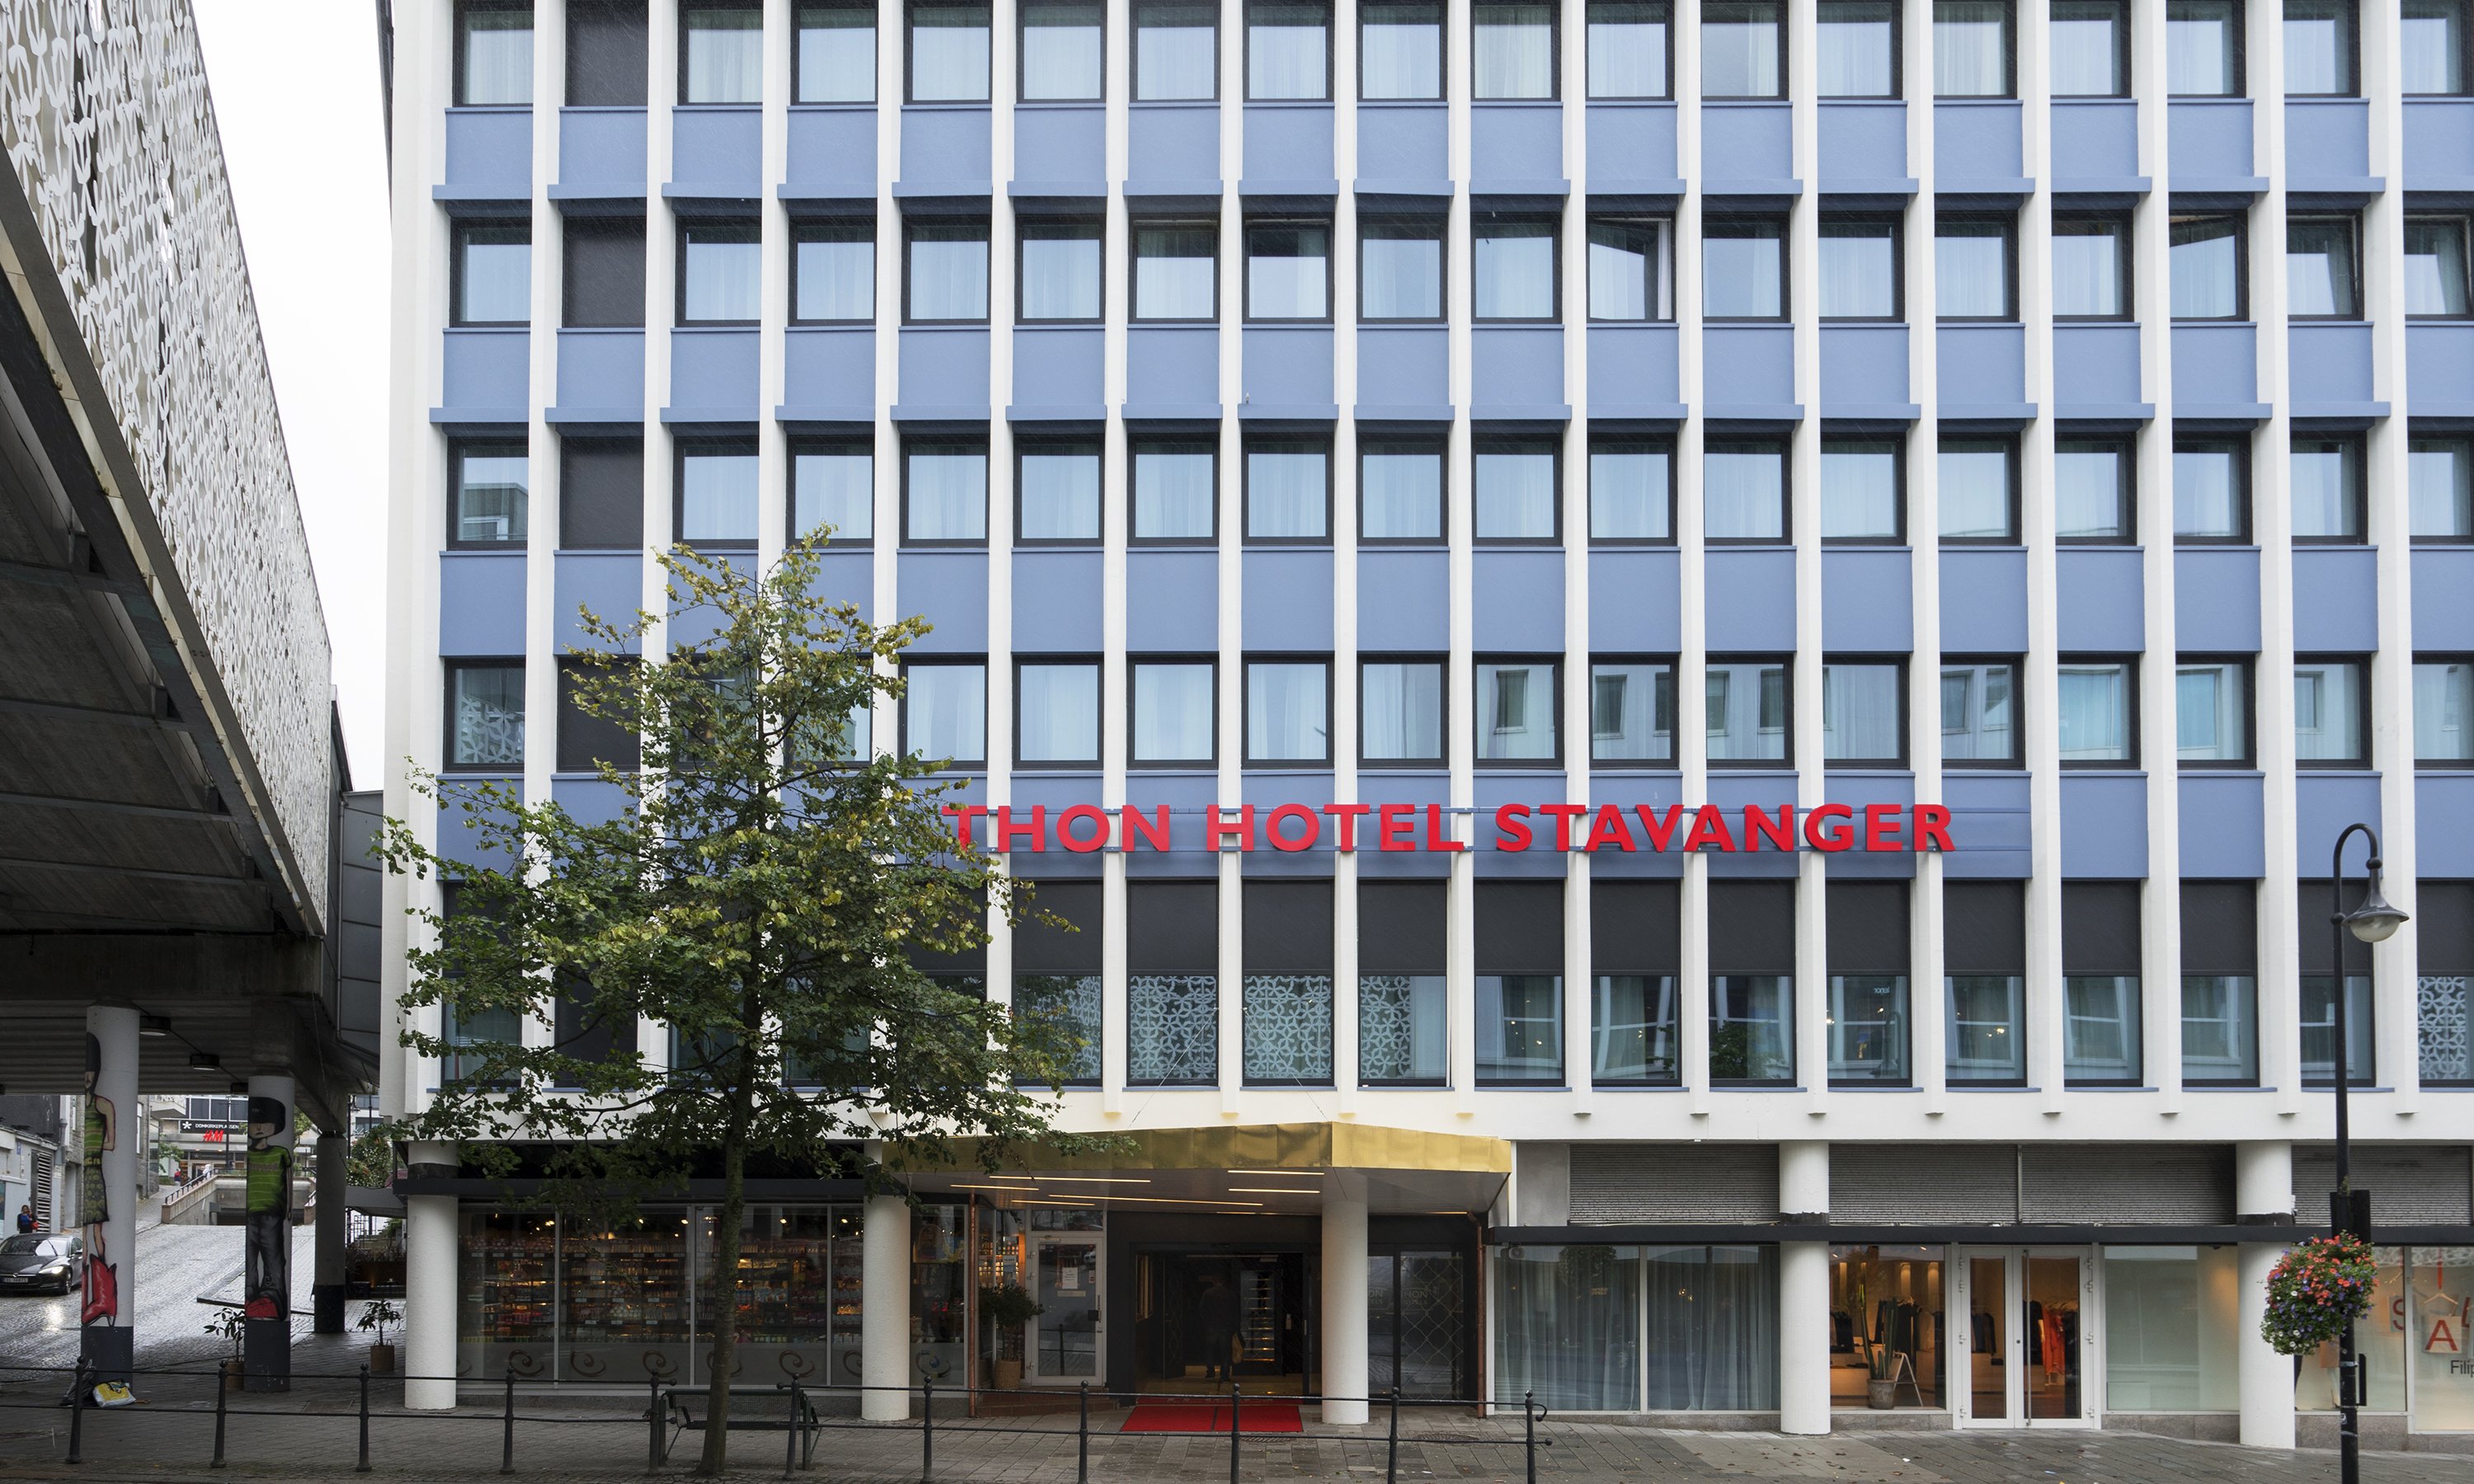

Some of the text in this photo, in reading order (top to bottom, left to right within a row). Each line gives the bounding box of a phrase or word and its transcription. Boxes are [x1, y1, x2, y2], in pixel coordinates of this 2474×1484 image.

[942, 803, 1955, 852] THON HOTEL STAVANGER
